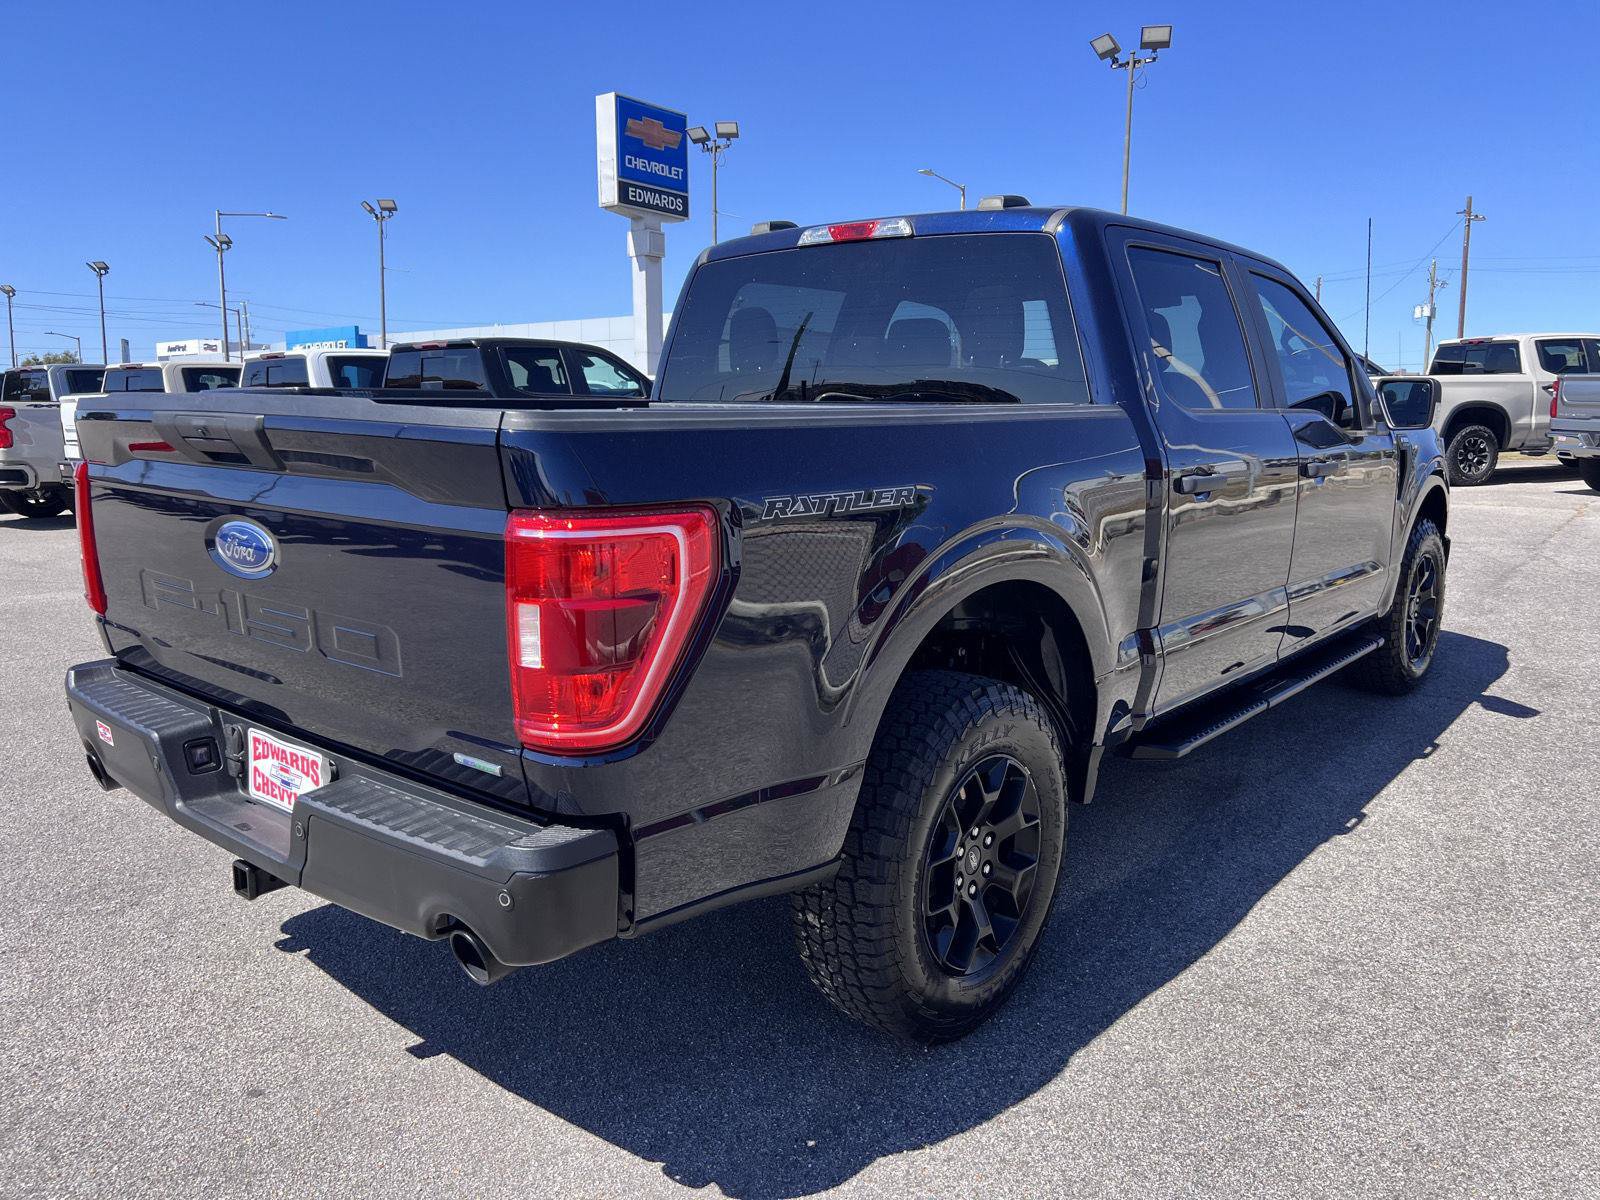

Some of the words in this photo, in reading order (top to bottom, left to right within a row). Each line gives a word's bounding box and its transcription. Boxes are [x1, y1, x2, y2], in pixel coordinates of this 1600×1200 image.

[625, 155, 683, 180] CHEVROLET
[628, 187, 683, 211] EDWARDS
[762, 486, 916, 519] RATTLER
[225, 531, 256, 562] Ford
[252, 736, 320, 787] EDWARDS
